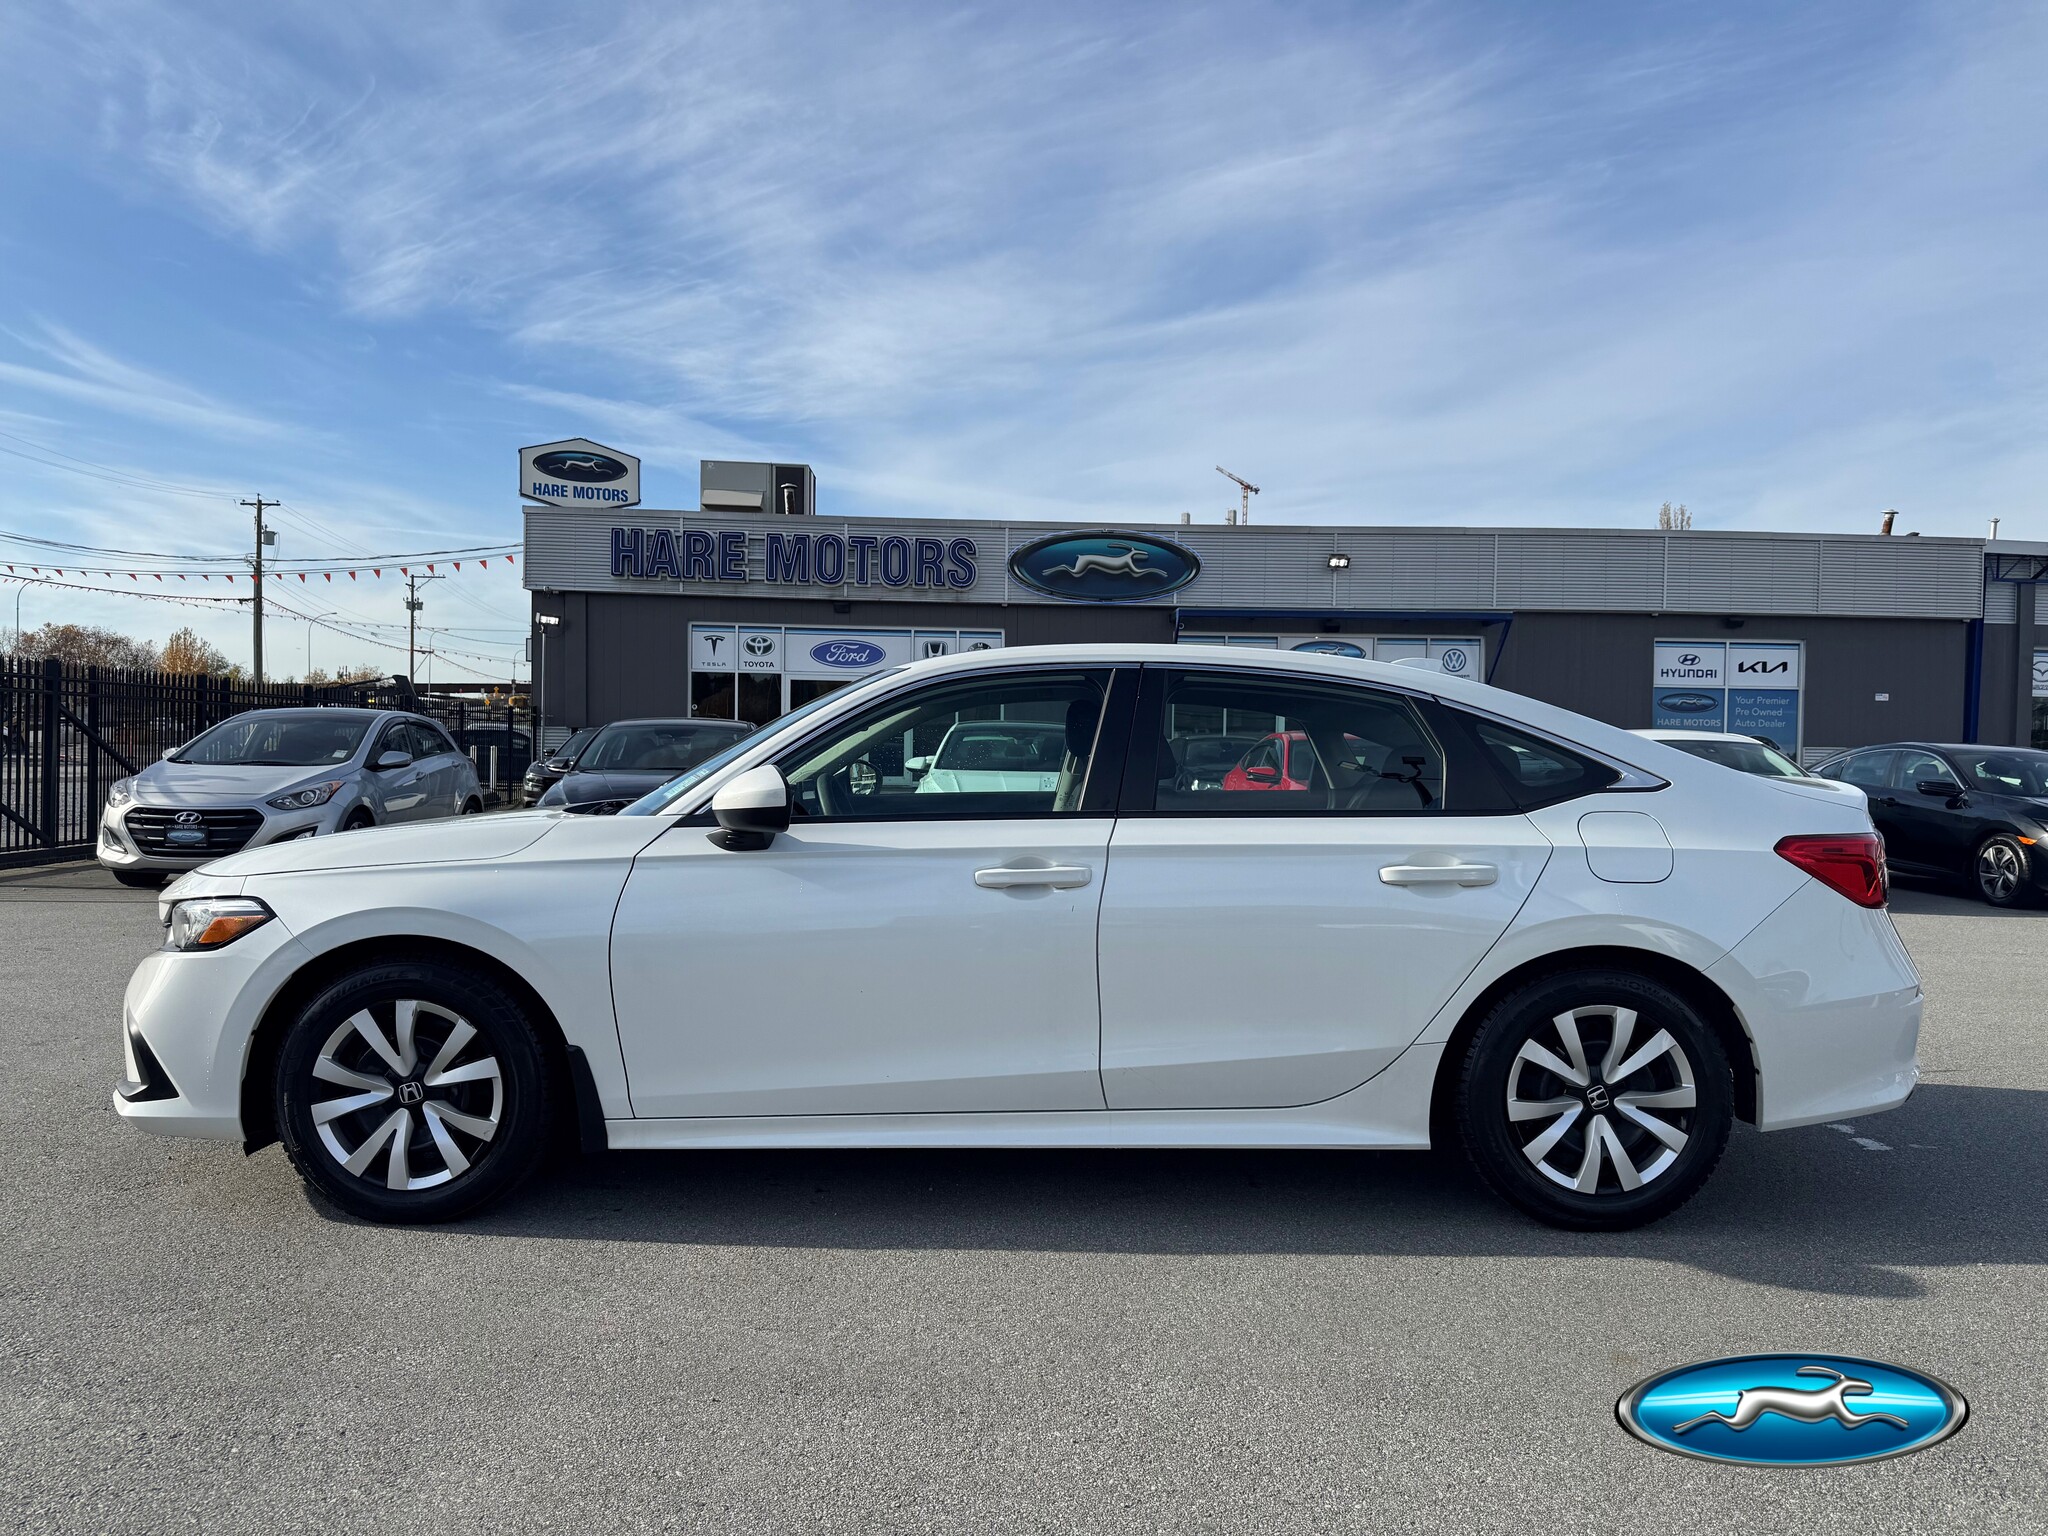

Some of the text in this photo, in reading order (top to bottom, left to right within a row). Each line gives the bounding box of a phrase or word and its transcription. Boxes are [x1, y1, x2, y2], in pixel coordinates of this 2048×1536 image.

[532, 482, 629, 503] HARE MOTORS
[610, 527, 979, 588] HARE MOTORS
[825, 643, 869, 663] Ford
[1738, 661, 1788, 674] KIA
[1660, 668, 1717, 679] HYUNDAI
[1735, 695, 1789, 705] Your Premier
[1735, 708, 1783, 717] Pre Owned
[1657, 718, 1721, 728] HARE MOTORS
[1735, 719, 1786, 728] Auto Dealer
